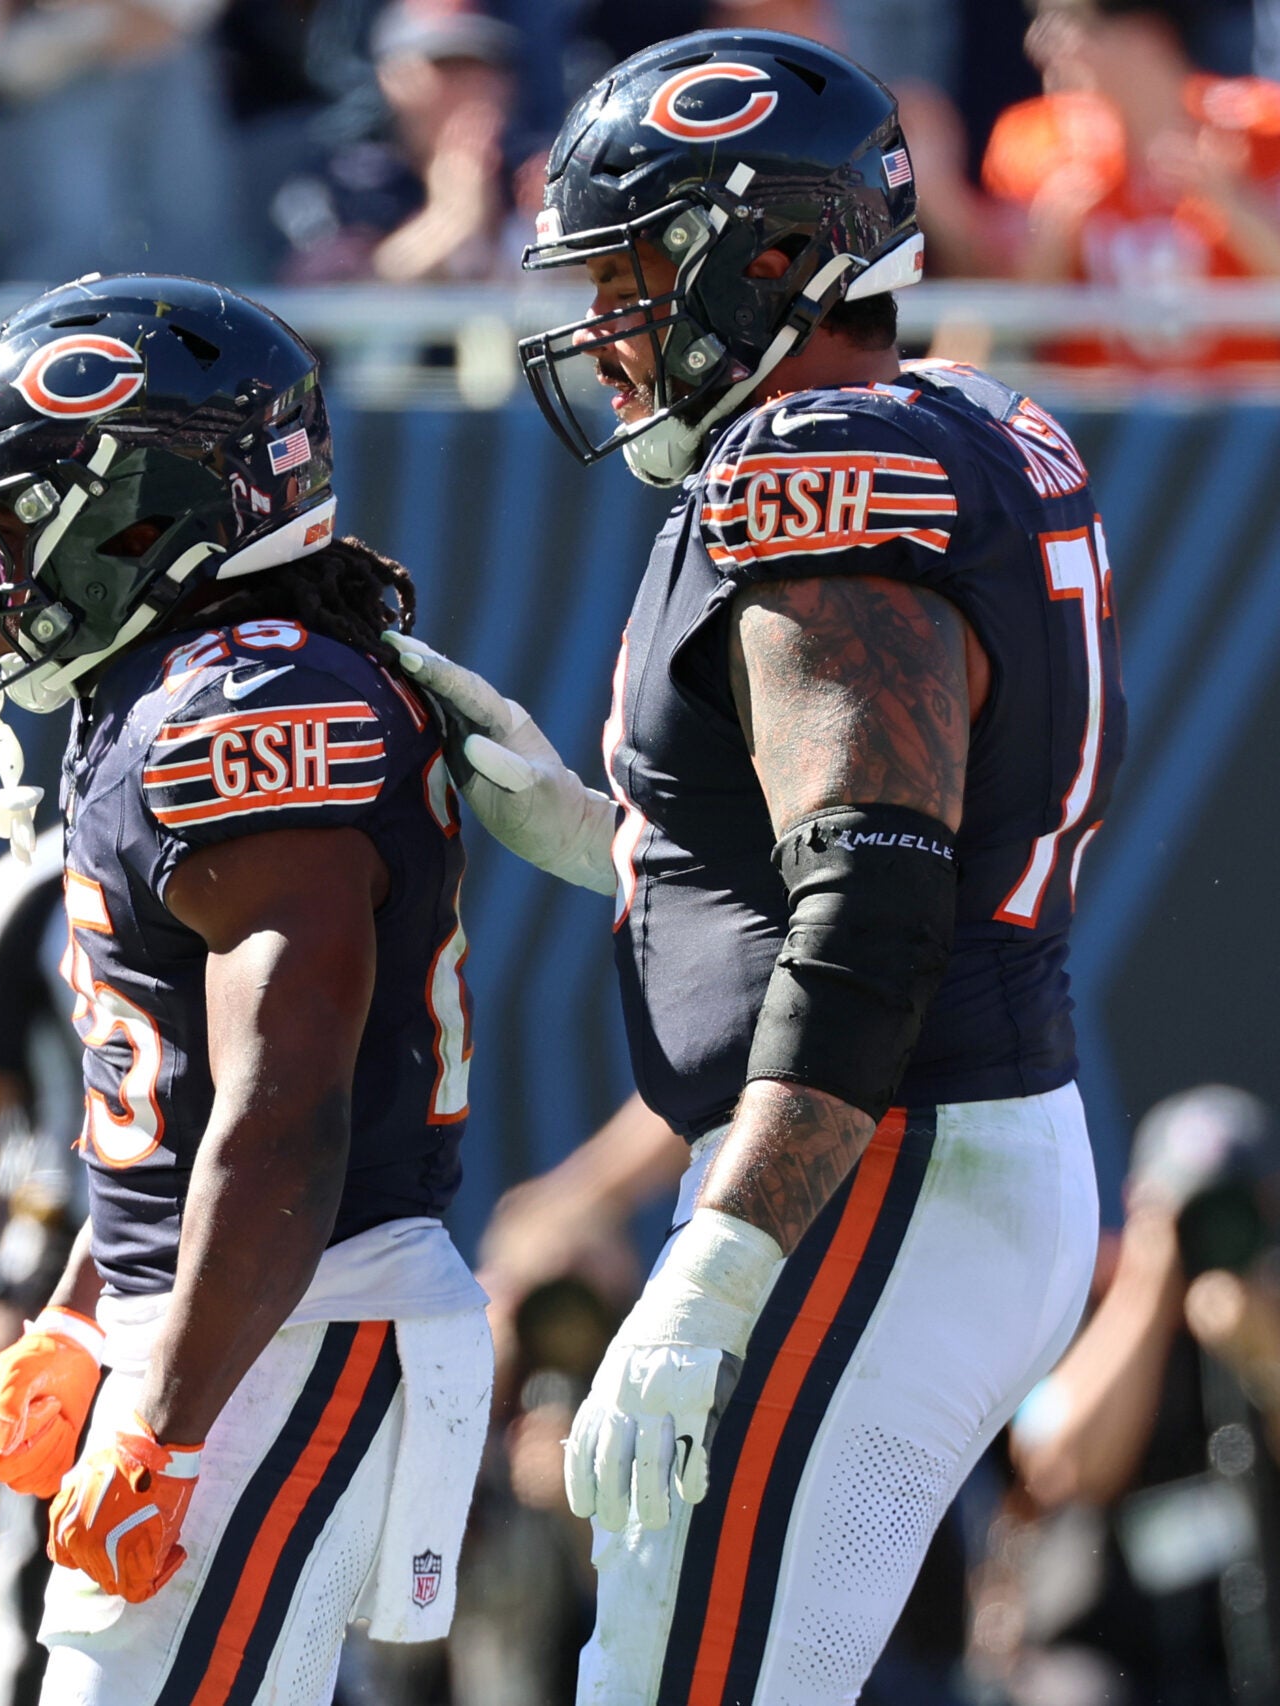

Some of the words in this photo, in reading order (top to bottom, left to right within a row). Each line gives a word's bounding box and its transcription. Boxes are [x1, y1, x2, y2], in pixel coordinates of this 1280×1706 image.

[746, 466, 873, 541] GSH
[161, 616, 309, 696] 25
[209, 717, 331, 799] GSH
[414, 1575, 437, 1601] NFL
